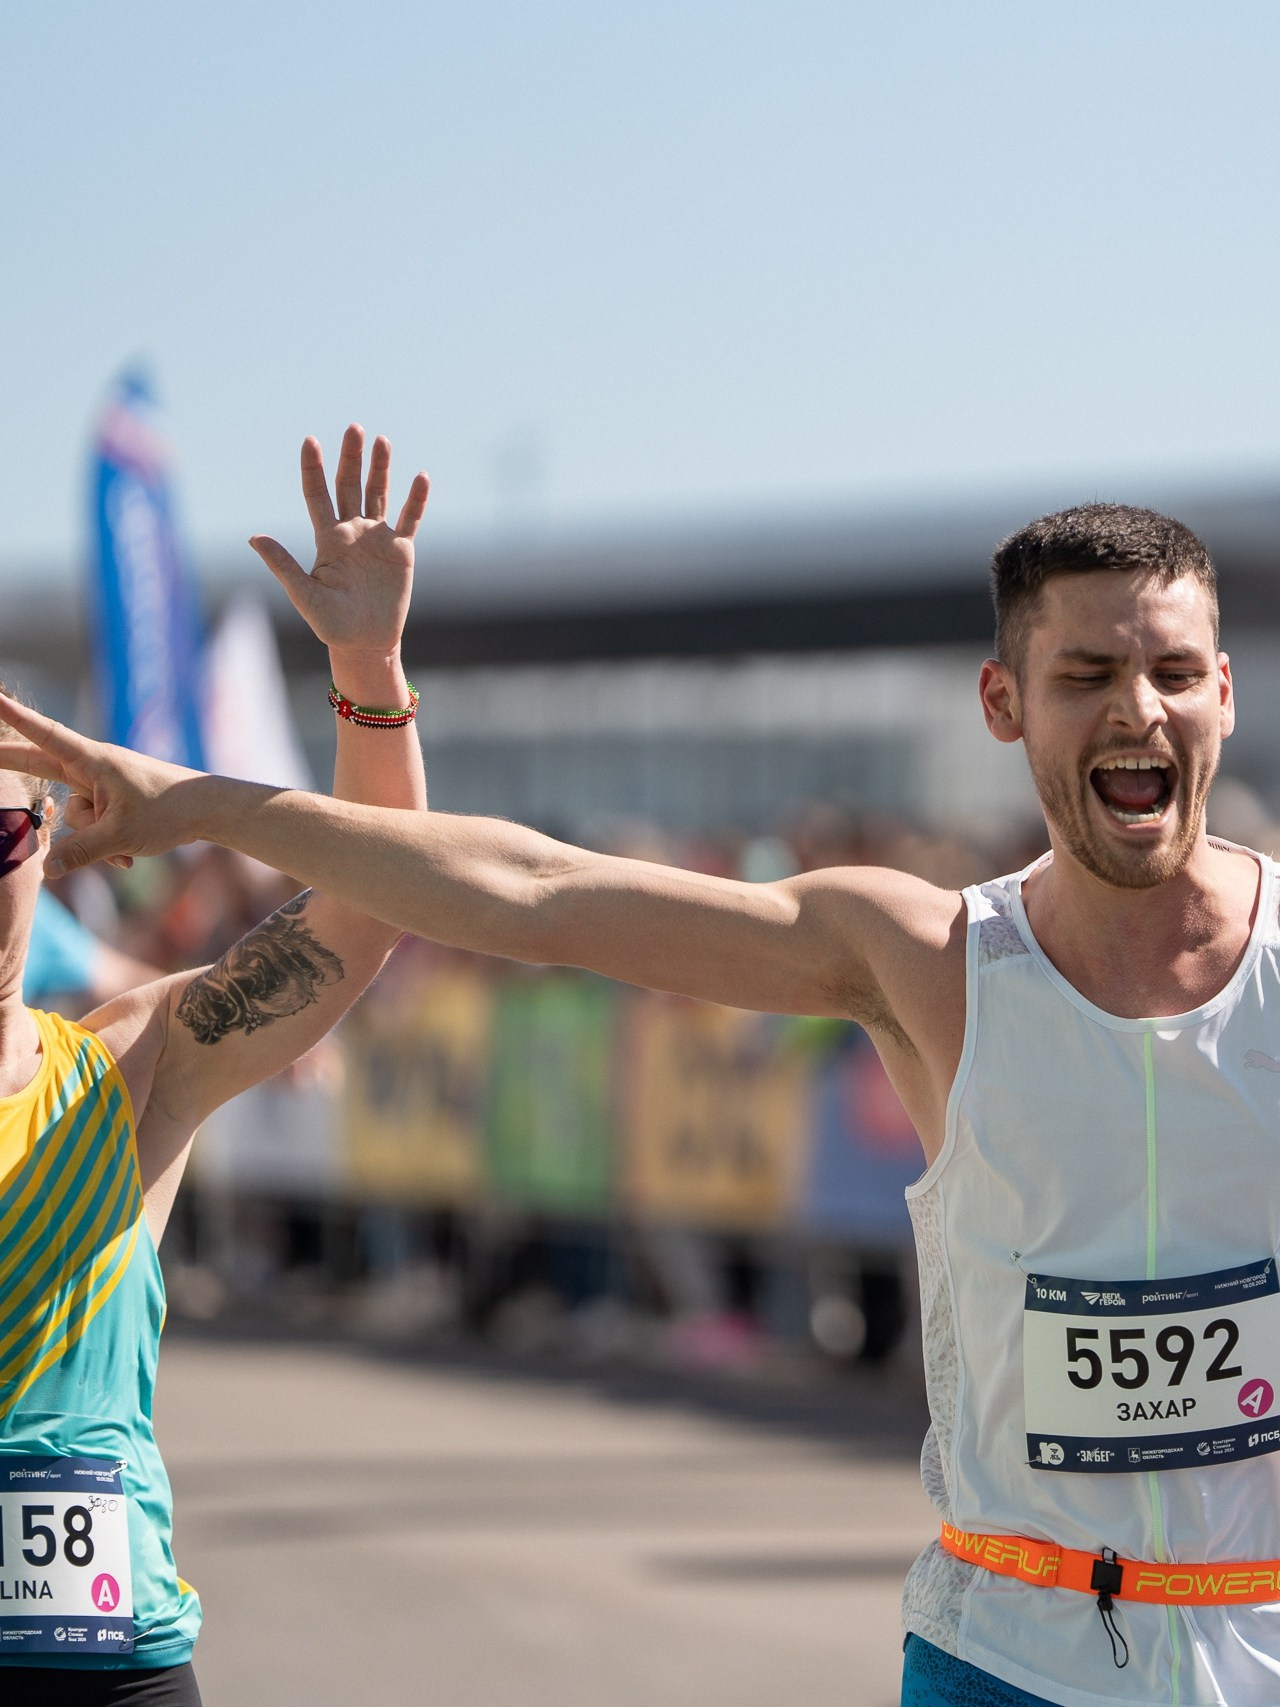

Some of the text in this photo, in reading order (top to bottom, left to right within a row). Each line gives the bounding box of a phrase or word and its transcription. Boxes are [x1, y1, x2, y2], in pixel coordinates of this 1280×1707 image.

[1035, 1287, 1047, 1299] 10
[1065, 1318, 1243, 1390] 5592
[1116, 1398, 1197, 1422] ЗАХАР
[1261, 1430, 1280, 1443] ПСБ
[1, 1579, 53, 1600] LINA
